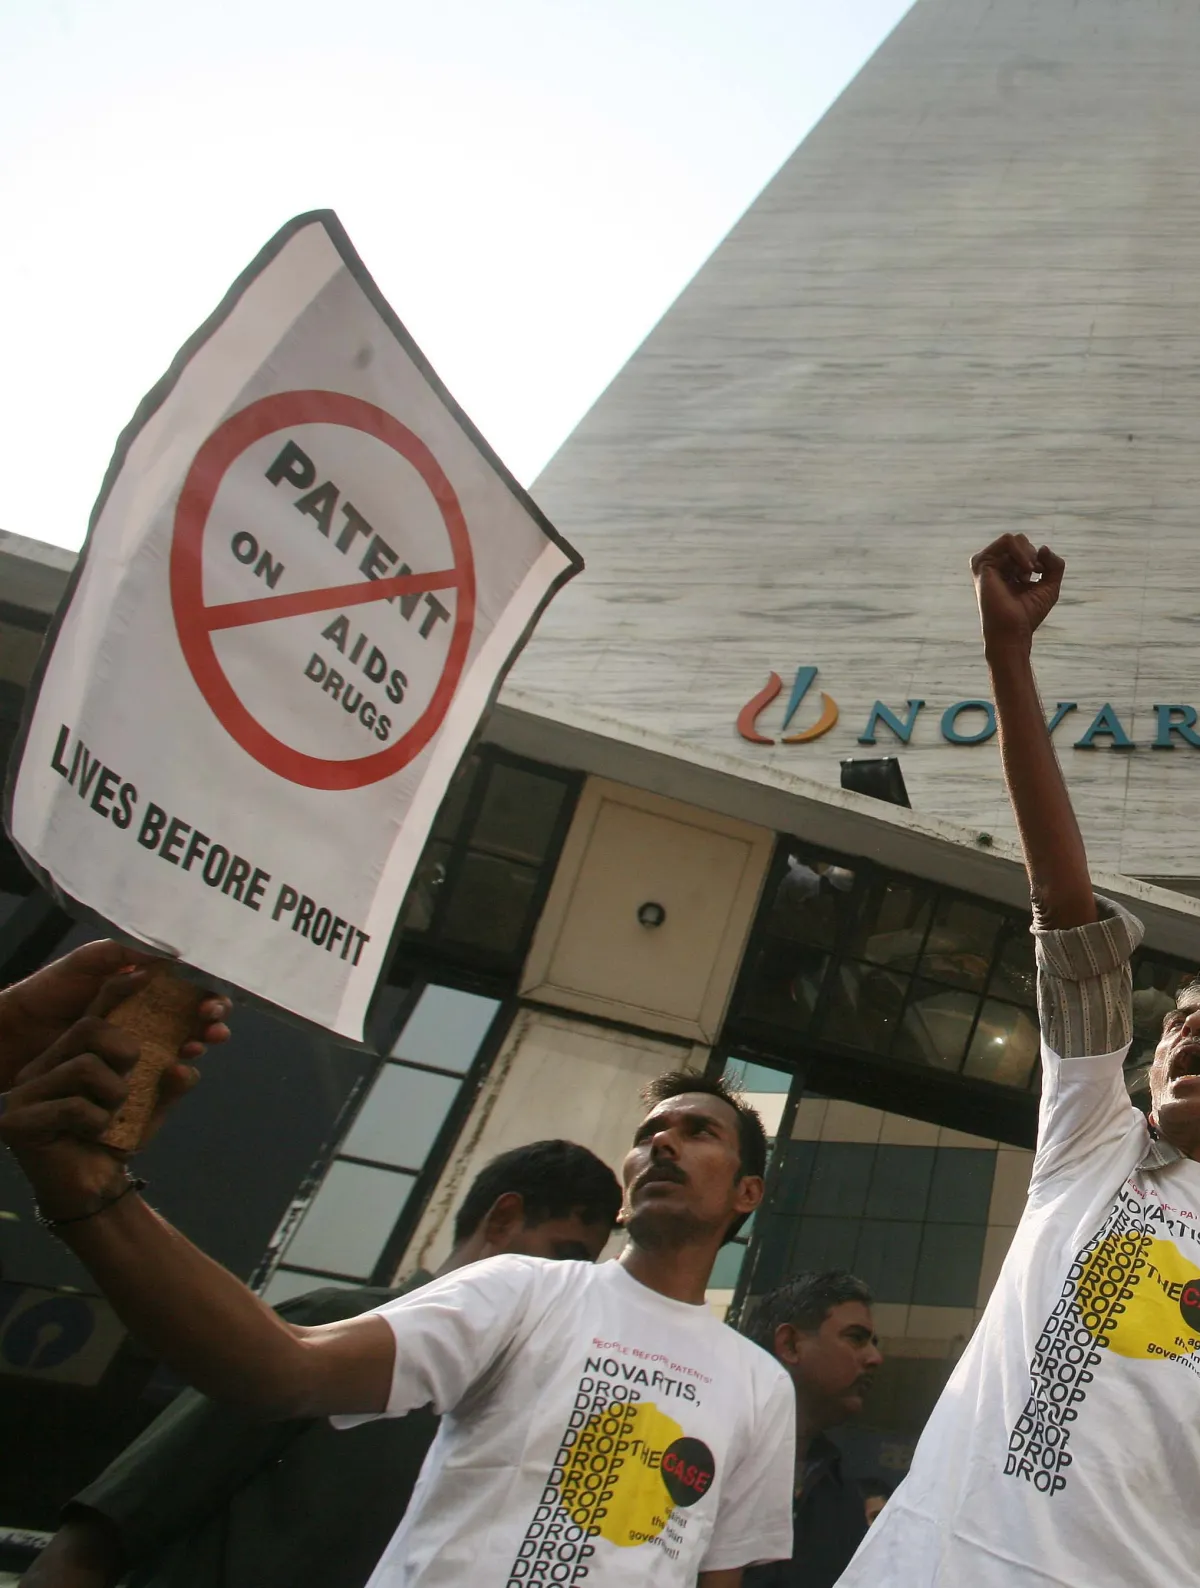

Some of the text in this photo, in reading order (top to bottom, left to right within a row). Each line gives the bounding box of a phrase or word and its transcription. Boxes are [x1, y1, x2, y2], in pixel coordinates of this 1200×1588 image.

[263, 439, 451, 640] PATENT
[229, 530, 285, 591] ON
[321, 614, 410, 706] AIDS
[303, 652, 394, 742] DRUGS
[51, 724, 370, 967] LIVES BEFORE PROFIT
[1074, 1250, 1140, 1288] DROP
[1083, 1240, 1146, 1273] DROP
[1061, 1280, 1126, 1318] DROP
[1067, 1264, 1134, 1302] DROP
[1043, 1316, 1110, 1351] DROP
[1052, 1299, 1117, 1334] DROP
[1035, 1333, 1102, 1368] DROP
[584, 1357, 701, 1407] NOVARTIS,
[1030, 1351, 1094, 1388] DROP
[574, 1393, 637, 1421] DROP
[579, 1377, 641, 1406] DROP
[569, 1410, 633, 1438] DROP
[1022, 1397, 1078, 1427] DROP
[1014, 1413, 1071, 1451] DROP
[554, 1448, 624, 1475] DROP
[561, 1429, 711, 1493] DROP THE CASE
[1008, 1430, 1073, 1473] DROP
[547, 1467, 618, 1491] DROP
[1003, 1453, 1067, 1497] DROP
[539, 1486, 613, 1508] DROP
[524, 1522, 602, 1543] DROP
[532, 1506, 608, 1525] DROP
[517, 1540, 595, 1564] DROP
[510, 1558, 589, 1584] DROP
